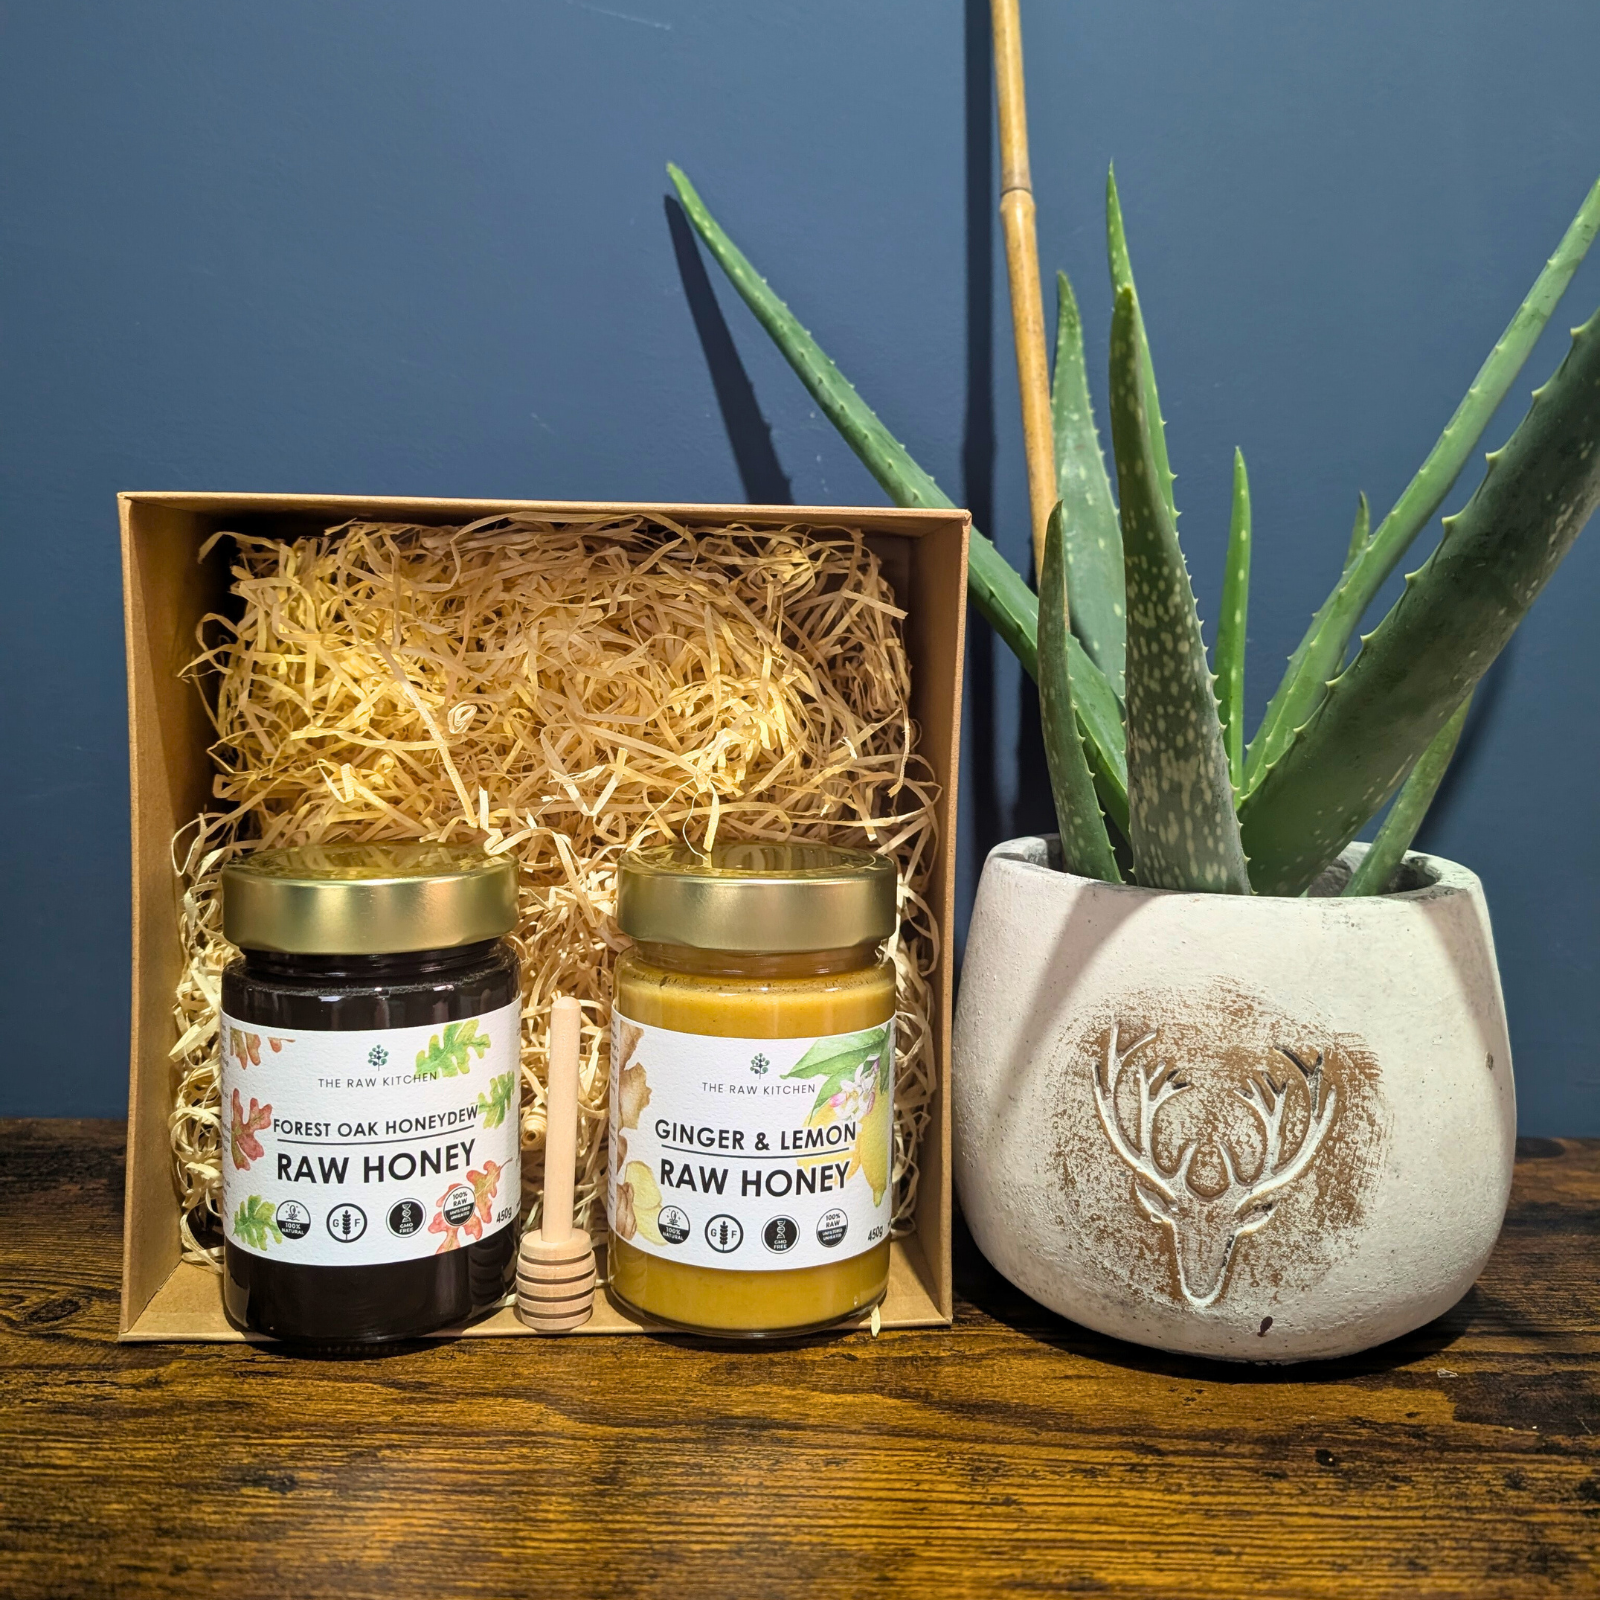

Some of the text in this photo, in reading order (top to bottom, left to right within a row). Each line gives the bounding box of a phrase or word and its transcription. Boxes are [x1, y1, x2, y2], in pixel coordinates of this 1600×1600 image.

[318, 1071, 437, 1089] THE RAW KITCHEN
[702, 1082, 815, 1096] THE RAW KITCHEN
[273, 1105, 479, 1137] FOREST OAK HONEYDEW
[655, 1119, 856, 1150] GINGER & LEMON
[277, 1138, 475, 1184] RAW HONEY
[660, 1158, 850, 1197] RAW HONEY
[452, 1191, 468, 1200] 100%
[453, 1198, 468, 1207] RAW
[496, 1206, 512, 1223] 450g
[825, 1213, 841, 1221] 100%
[285, 1222, 301, 1230] 100%
[825, 1220, 841, 1228] RAW
[281, 1228, 305, 1236] NATURAL
[662, 1231, 684, 1241] NATURAL
[665, 1226, 681, 1235] 100%
[867, 1225, 883, 1242] 450g
